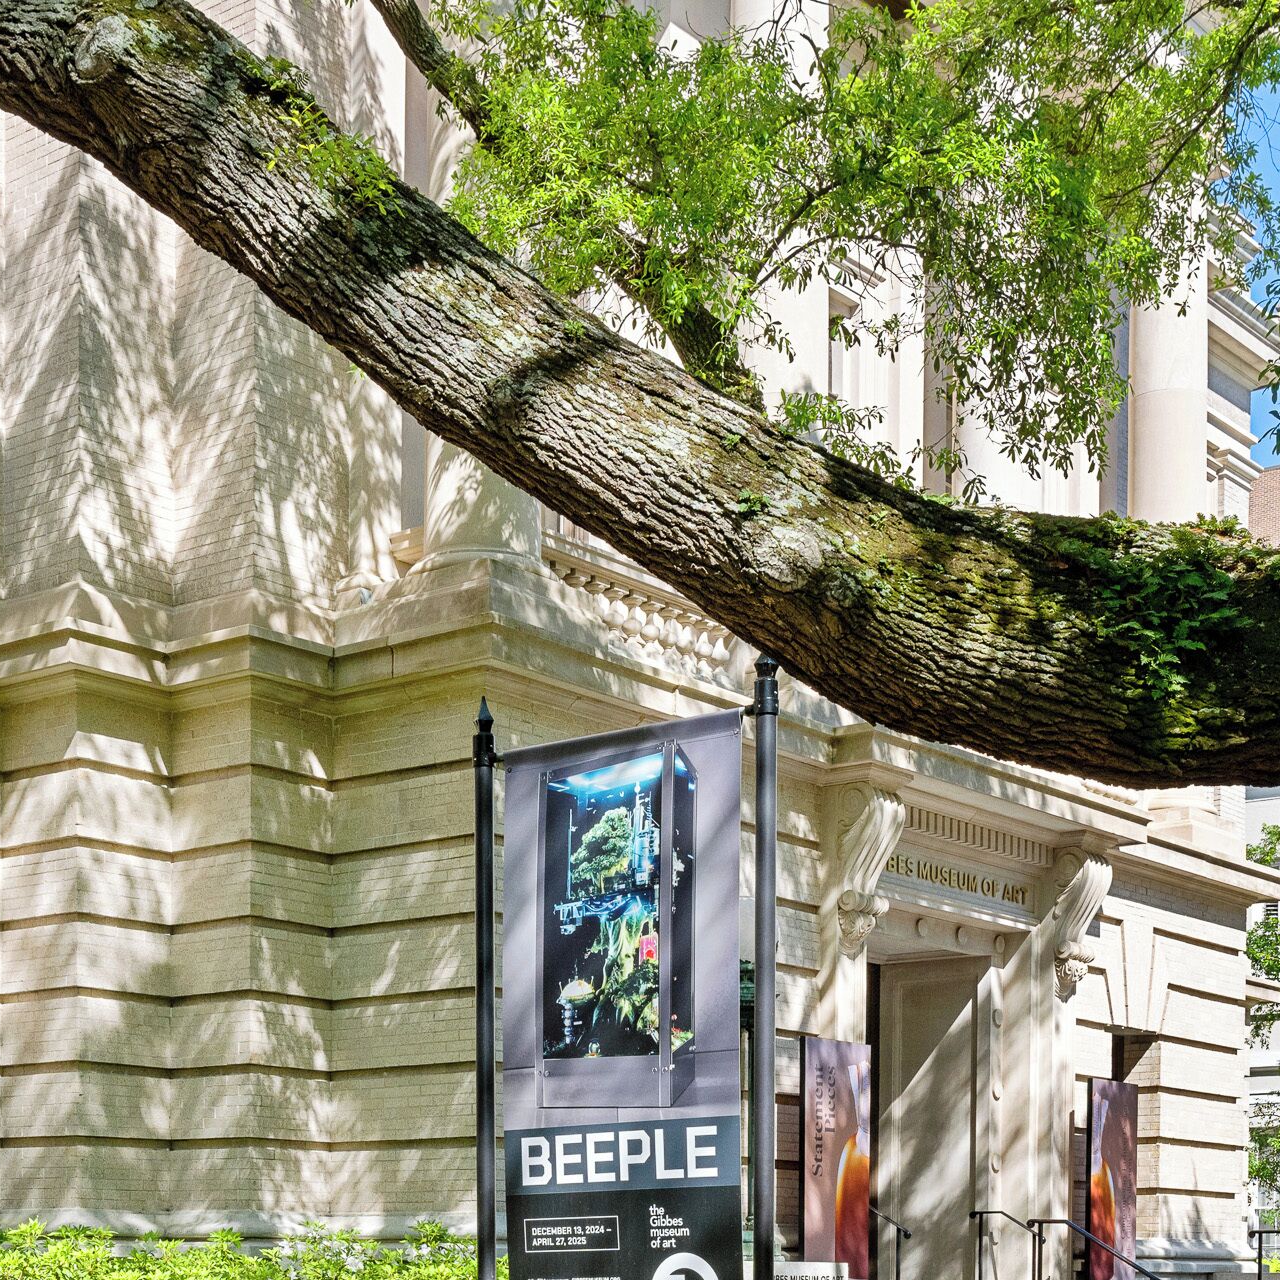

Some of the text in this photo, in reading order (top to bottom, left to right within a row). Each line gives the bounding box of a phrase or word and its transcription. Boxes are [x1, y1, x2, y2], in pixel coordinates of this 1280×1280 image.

[886, 854, 1029, 905] BES MUSEUM OF ART
[824, 1065, 836, 1133] Pieces
[812, 1064, 824, 1177] Statement
[521, 1125, 719, 1186] BEEPLE
[649, 1204, 664, 1216] the
[650, 1215, 684, 1227] Gibbes
[532, 1227, 572, 1236] DECEMBER
[573, 1226, 585, 1236] 13,
[585, 1225, 605, 1234] 2024
[650, 1227, 690, 1237] museum
[532, 1236, 587, 1246] APRIL 27, 2025
[650, 1238, 676, 1248] of art
